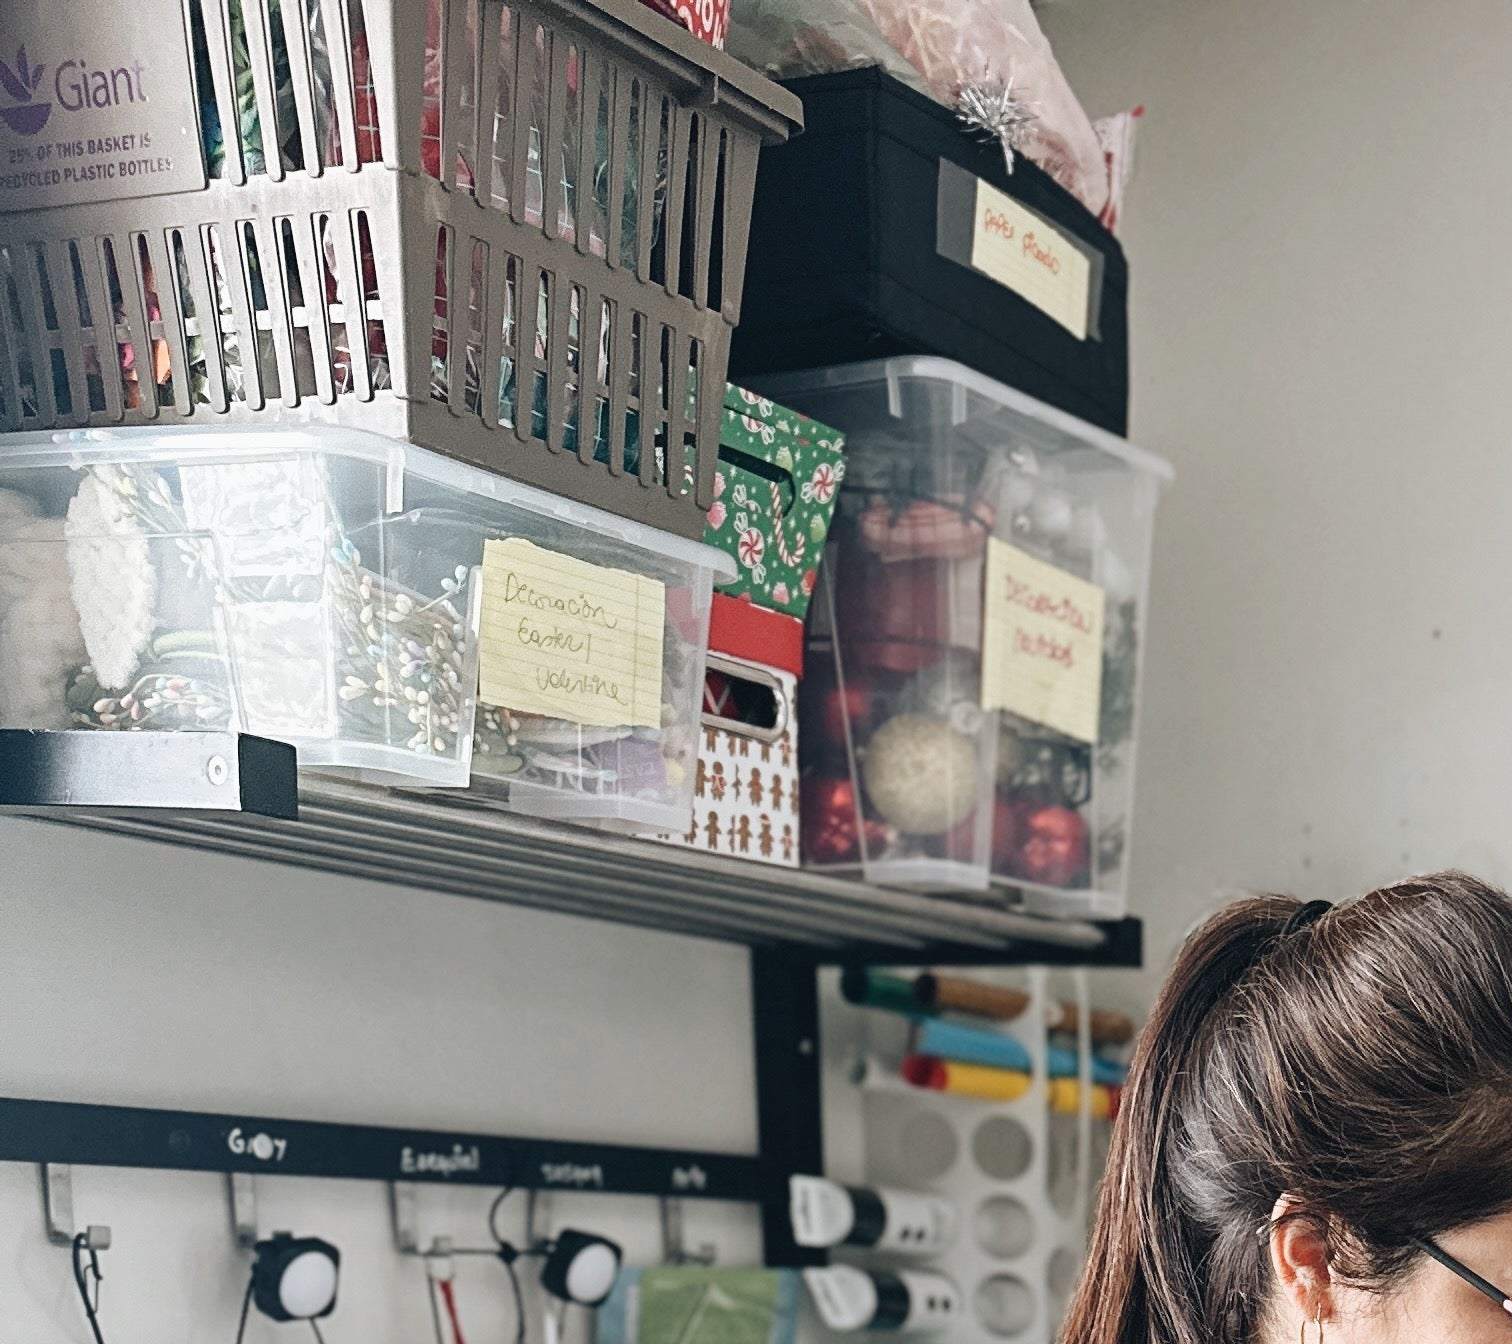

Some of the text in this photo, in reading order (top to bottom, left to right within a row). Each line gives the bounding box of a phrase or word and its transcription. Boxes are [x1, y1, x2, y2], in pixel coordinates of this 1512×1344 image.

[55, 58, 148, 112] Giant
[57, 141, 84, 159] THIS
[87, 134, 136, 155] BASKET
[139, 132, 151, 148] IS
[64, 162, 115, 184] PLASTIC
[118, 157, 174, 177] BOTTLES
